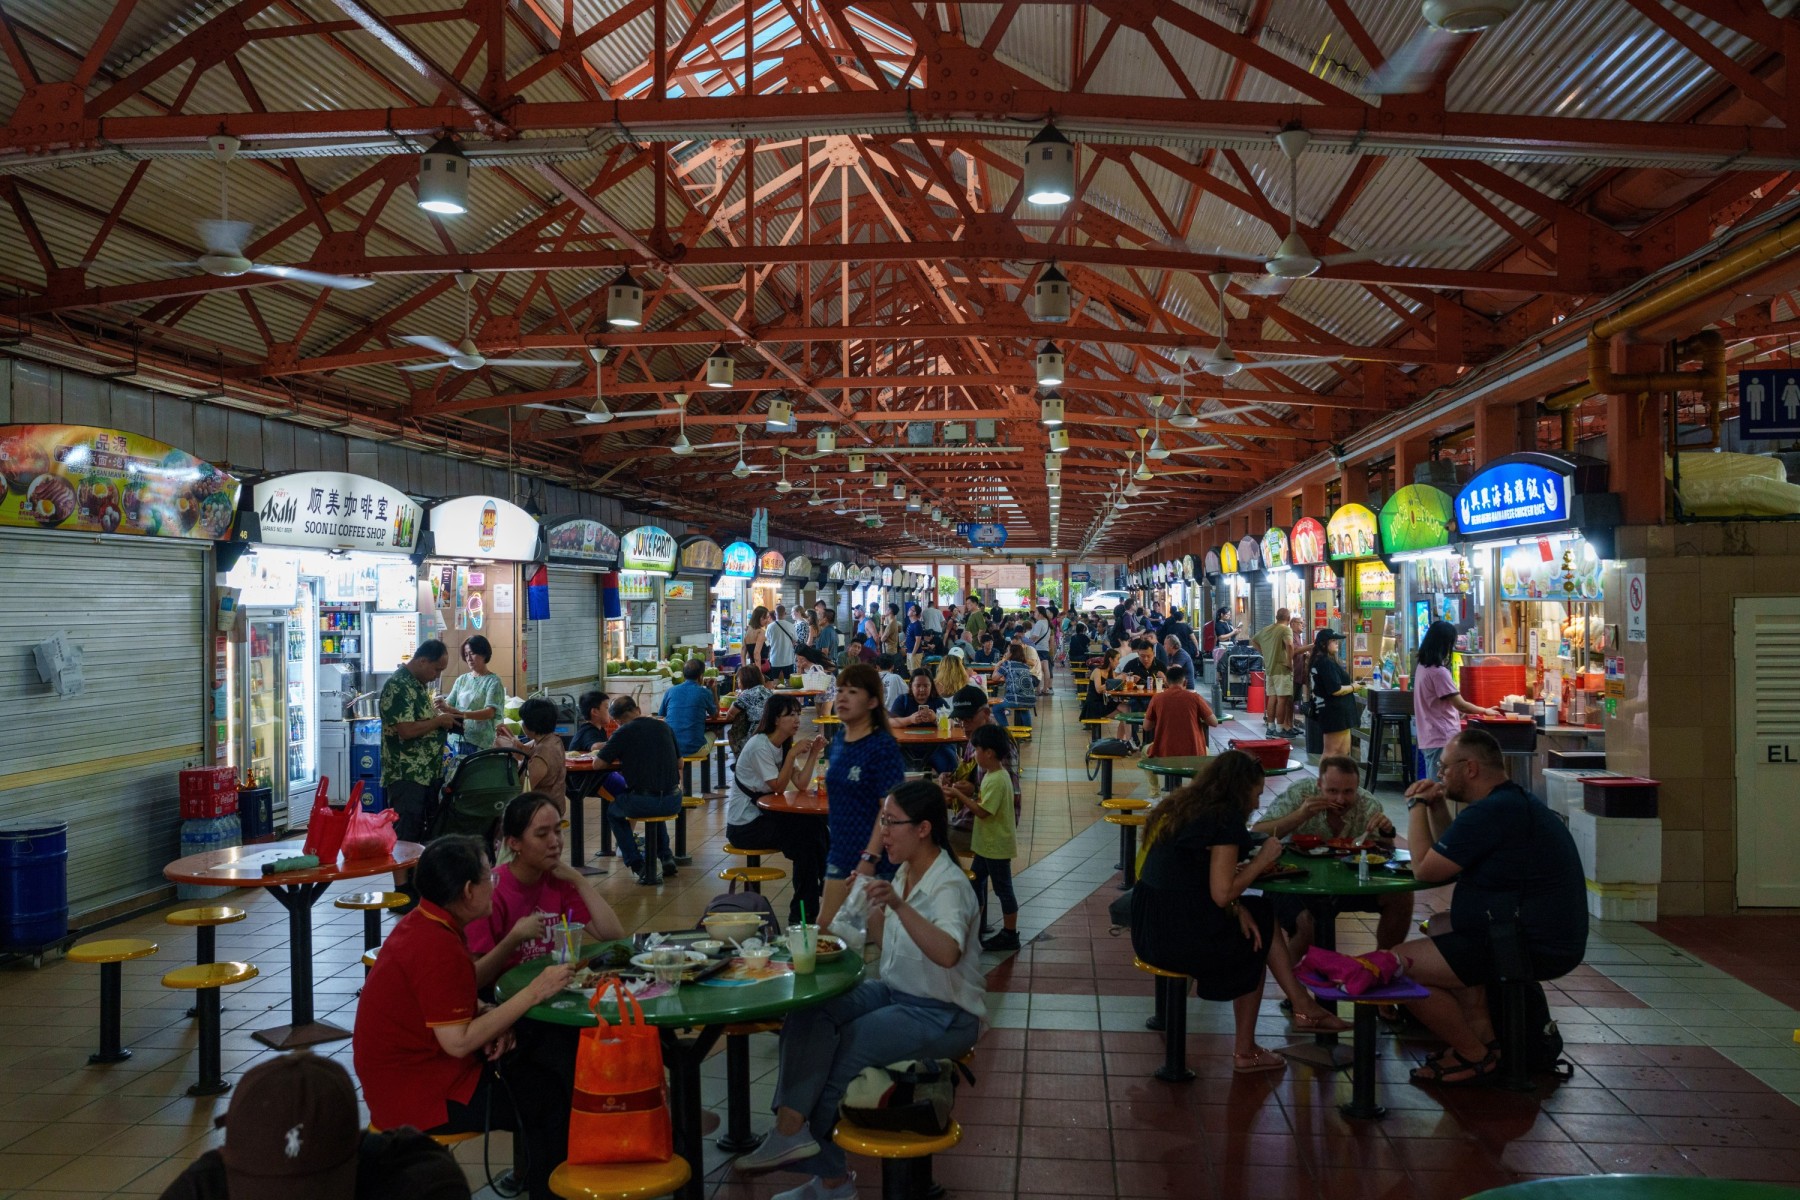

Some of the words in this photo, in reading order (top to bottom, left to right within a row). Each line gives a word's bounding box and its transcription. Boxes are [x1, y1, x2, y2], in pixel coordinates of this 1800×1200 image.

[96, 433, 128, 453] 品源
[261, 495, 298, 524] Asahi
[307, 487, 388, 521] 顺美咖啡室
[1533, 503, 1545, 515] RICE
[240, 530, 248, 540] 46
[304, 520, 329, 535] SOON
[329, 522, 337, 536] LI
[337, 523, 365, 539] COFFEE
[366, 527, 387, 540] SHOP
[633, 533, 652, 558] JUICE
[653, 533, 672, 559] FARM
[1633, 616, 1640, 625] NO
[1768, 745, 1798, 763] EL
